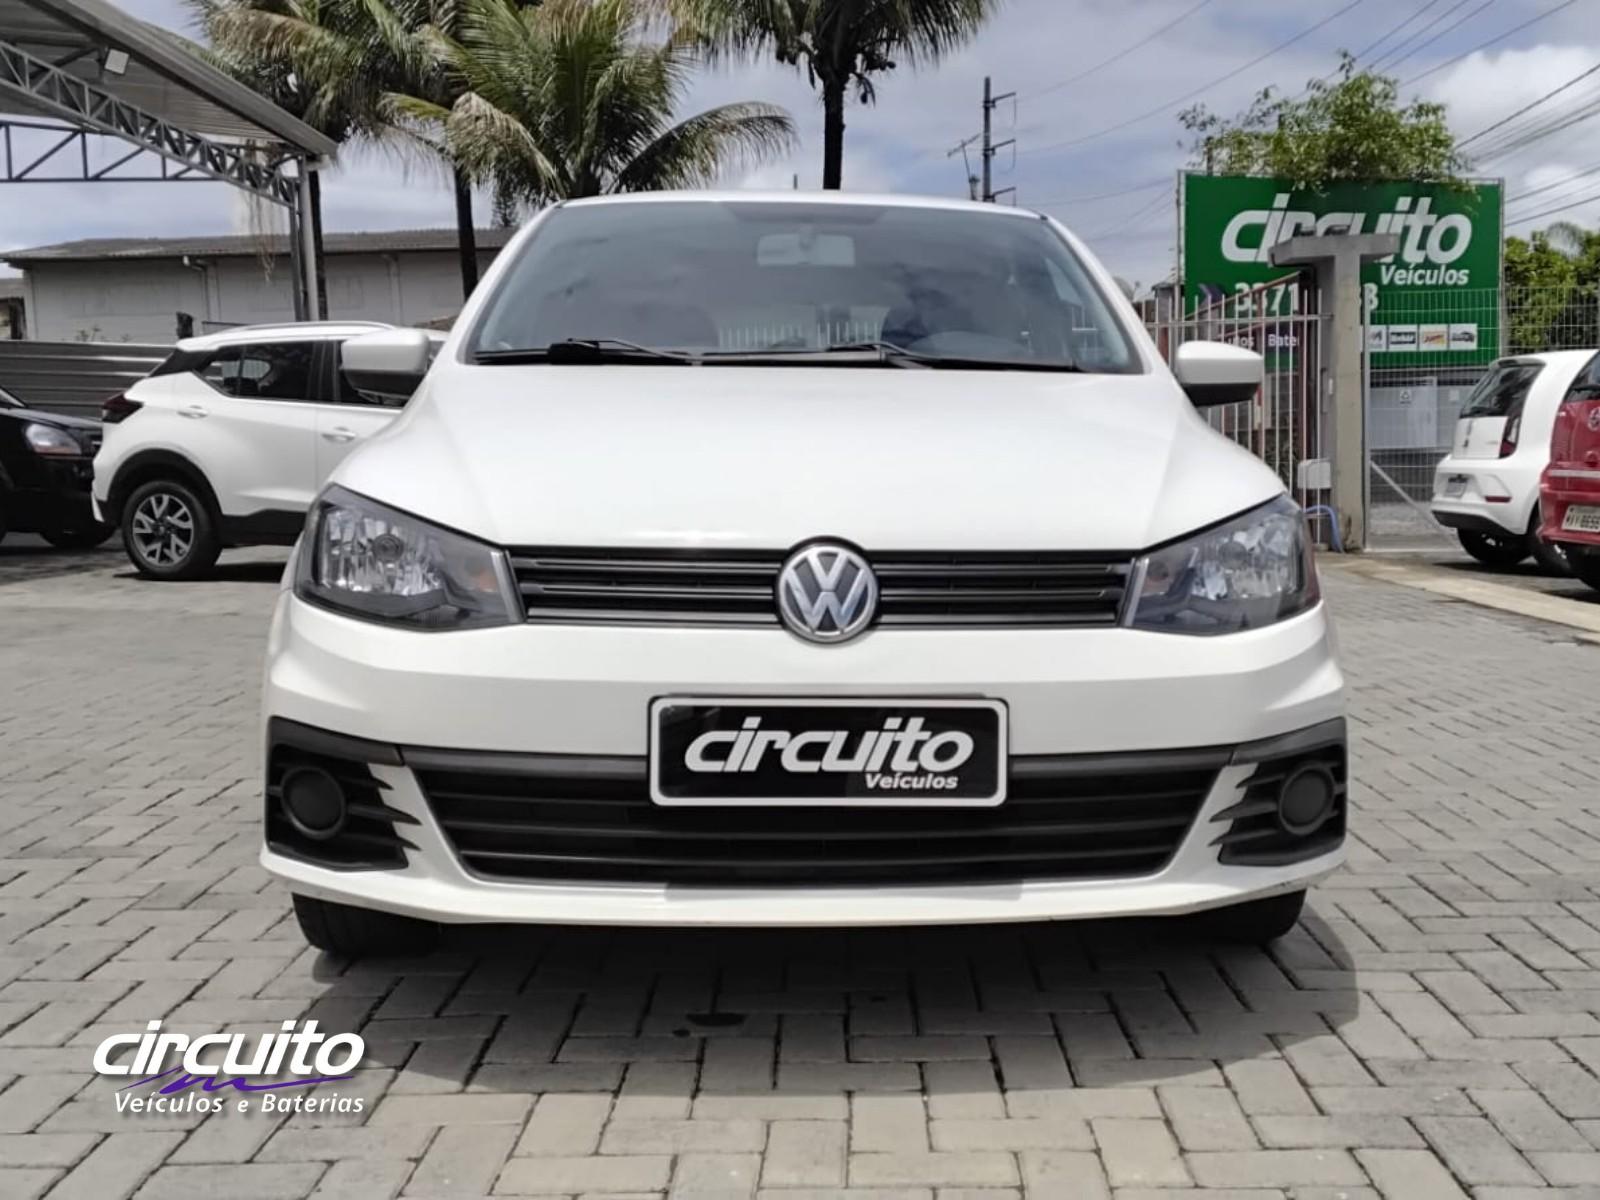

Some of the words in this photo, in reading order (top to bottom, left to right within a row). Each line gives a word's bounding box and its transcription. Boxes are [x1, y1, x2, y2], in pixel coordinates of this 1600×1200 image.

[1381, 262, 1470, 286] Veículos
[684, 716, 974, 773] circuito
[865, 772, 958, 789] Veículos
